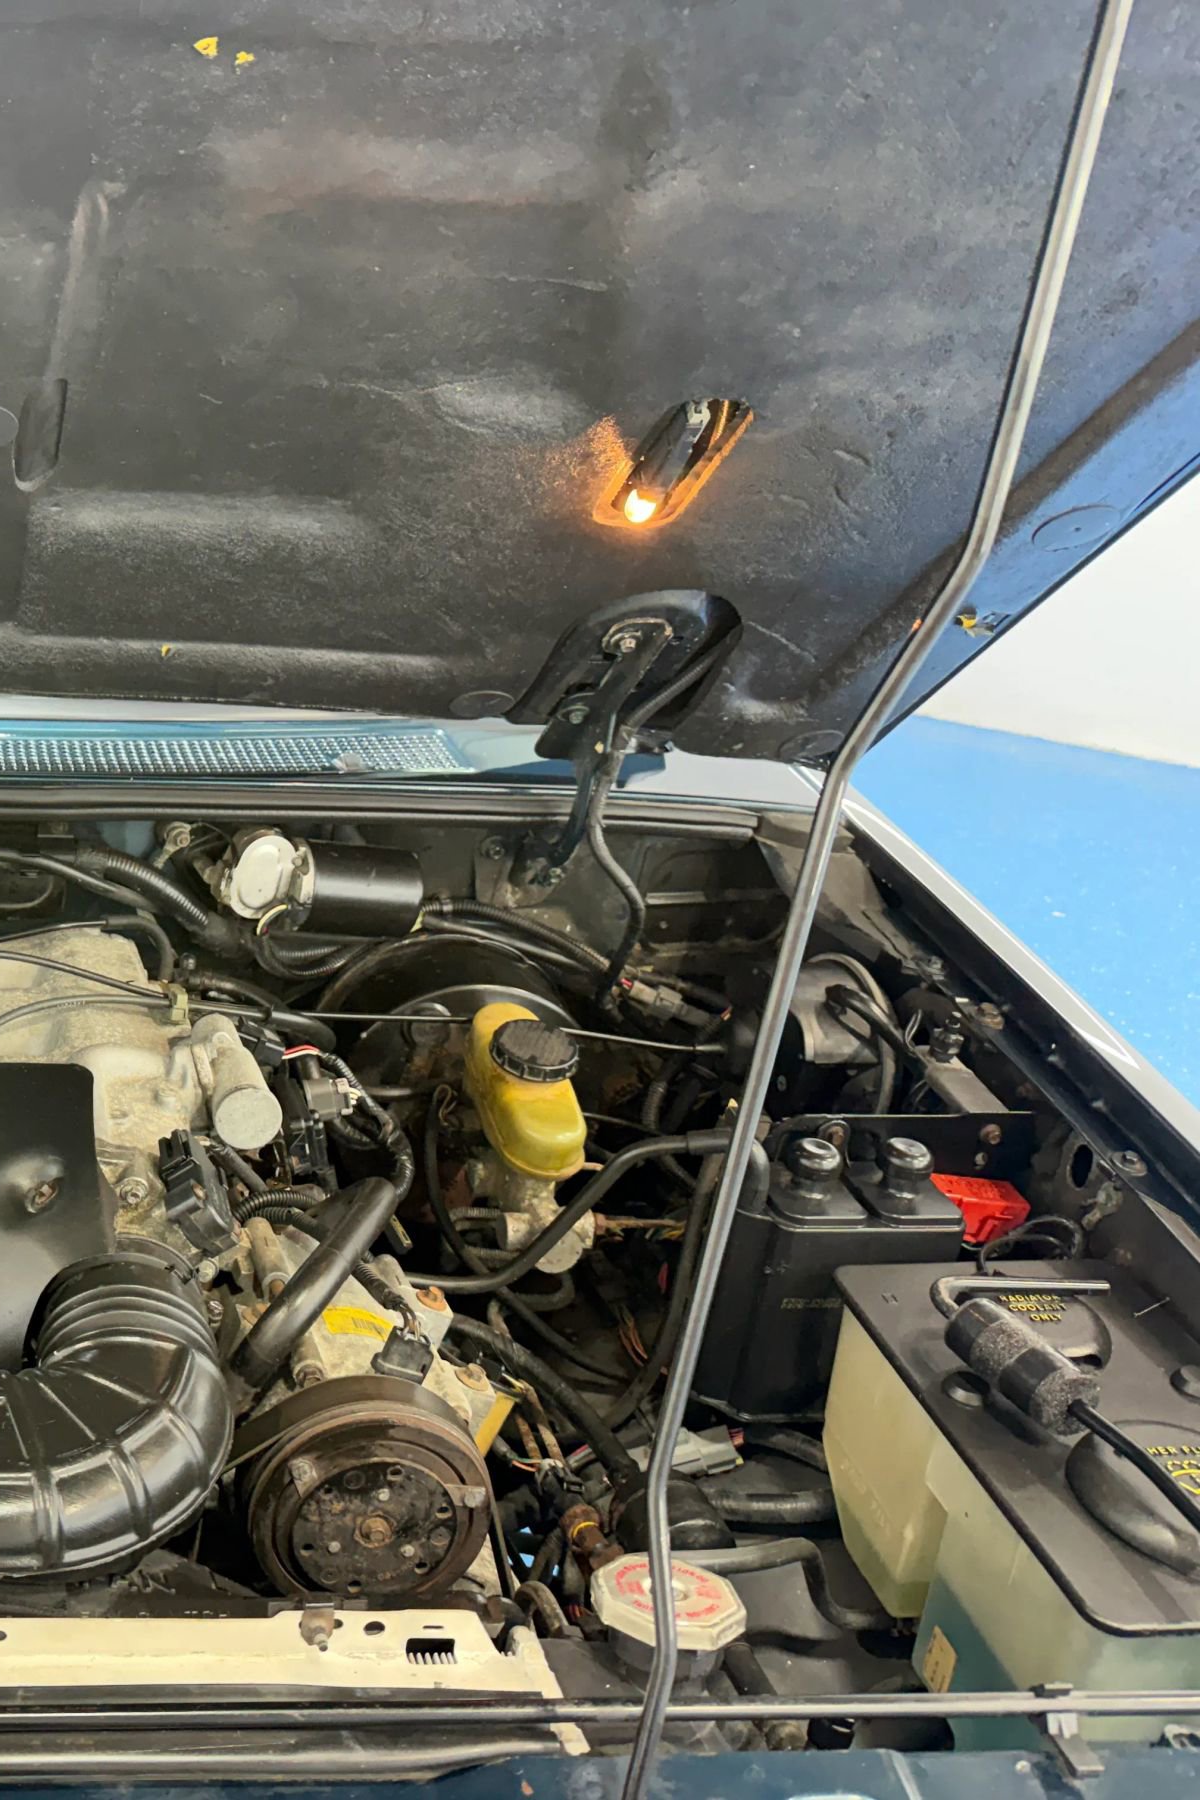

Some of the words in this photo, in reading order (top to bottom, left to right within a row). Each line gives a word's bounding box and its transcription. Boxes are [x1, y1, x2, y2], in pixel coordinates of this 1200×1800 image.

[999, 1294, 1061, 1303] RADIATOR
[1009, 1303, 1067, 1312] COOLANT
[1030, 1313, 1063, 1322] ONLY
[1146, 1446, 1178, 1455] HER
